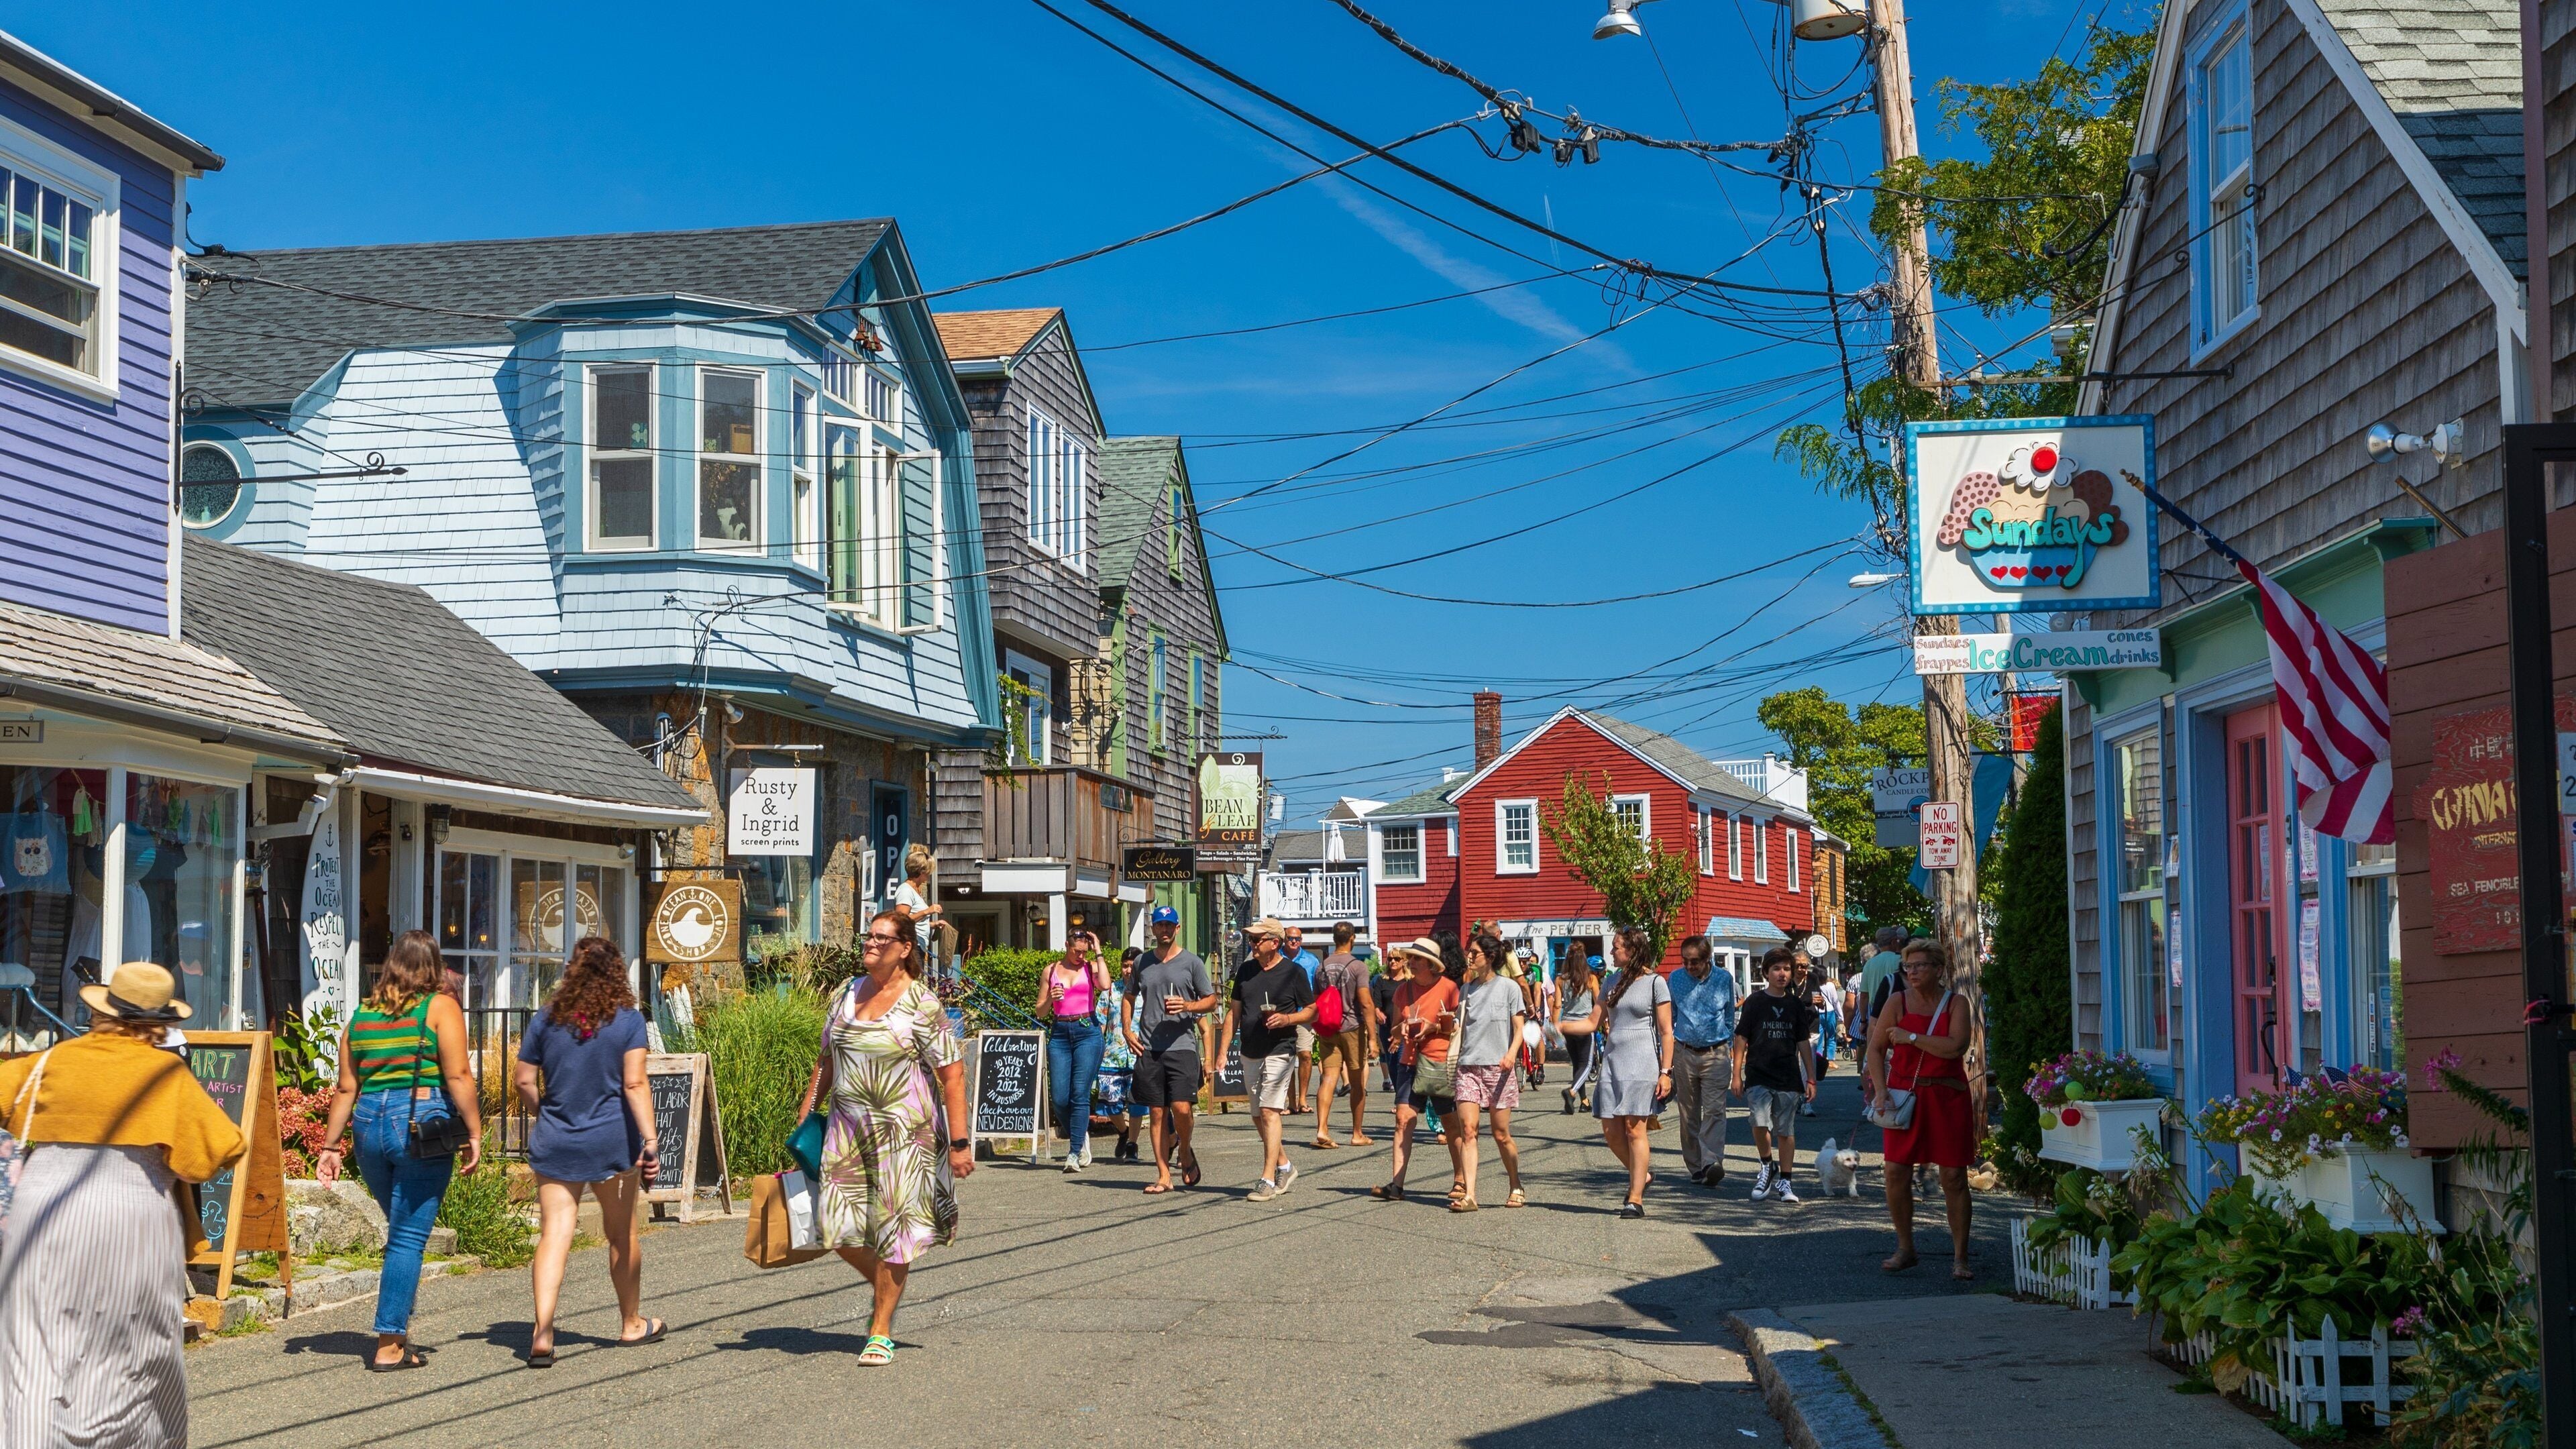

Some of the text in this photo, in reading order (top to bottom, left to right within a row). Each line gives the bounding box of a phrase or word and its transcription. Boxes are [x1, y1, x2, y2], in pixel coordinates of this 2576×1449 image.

[1962, 506, 2114, 589] Sundays
[1915, 638, 1970, 649] sundaes
[2106, 631, 2153, 643] cones
[2109, 648, 2159, 664] drinks
[1915, 654, 1969, 672] frappes
[745, 777, 798, 800] Rusty
[761, 798, 777, 815] &
[1204, 799, 1242, 814] BEAN
[2431, 779, 2508, 830] CHINA
[1217, 814, 1255, 826] LEAF
[1933, 808, 1947, 820] NO
[742, 814, 799, 837] Ingrid
[1924, 821, 1957, 834] PARKING
[1221, 829, 1255, 841] CAFÉ
[773, 837, 800, 849] prints
[1136, 851, 1181, 869] Gallery
[1127, 870, 1191, 879] MONTANARO
[325, 879, 335, 888] THE
[315, 886, 341, 908] OCEAN
[659, 891, 724, 939] ONE OCEAN ONE LOVE
[1523, 925, 1543, 934] The
[1550, 924, 1602, 936] PEWTER
[318, 941, 329, 949] THE
[679, 945, 706, 957] SHOP
[312, 956, 344, 981] OCEAN
[1762, 1021, 1793, 1030] AMERICAN
[1768, 1030, 1788, 1038] EAGLE
[983, 1036, 1038, 1065] Celebrating
[191, 1049, 236, 1079] ART
[995, 1055, 1024, 1069] 10 YEARS
[997, 1065, 1021, 1078] 2012
[207, 1081, 243, 1093] ARTIST
[996, 1079, 1019, 1092] 2022
[659, 1091, 690, 1110] LABOR
[986, 1088, 1025, 1104] IN BUSINESS
[979, 1102, 1005, 1115] Check
[977, 1115, 1034, 1131] NEW DESIGNS
